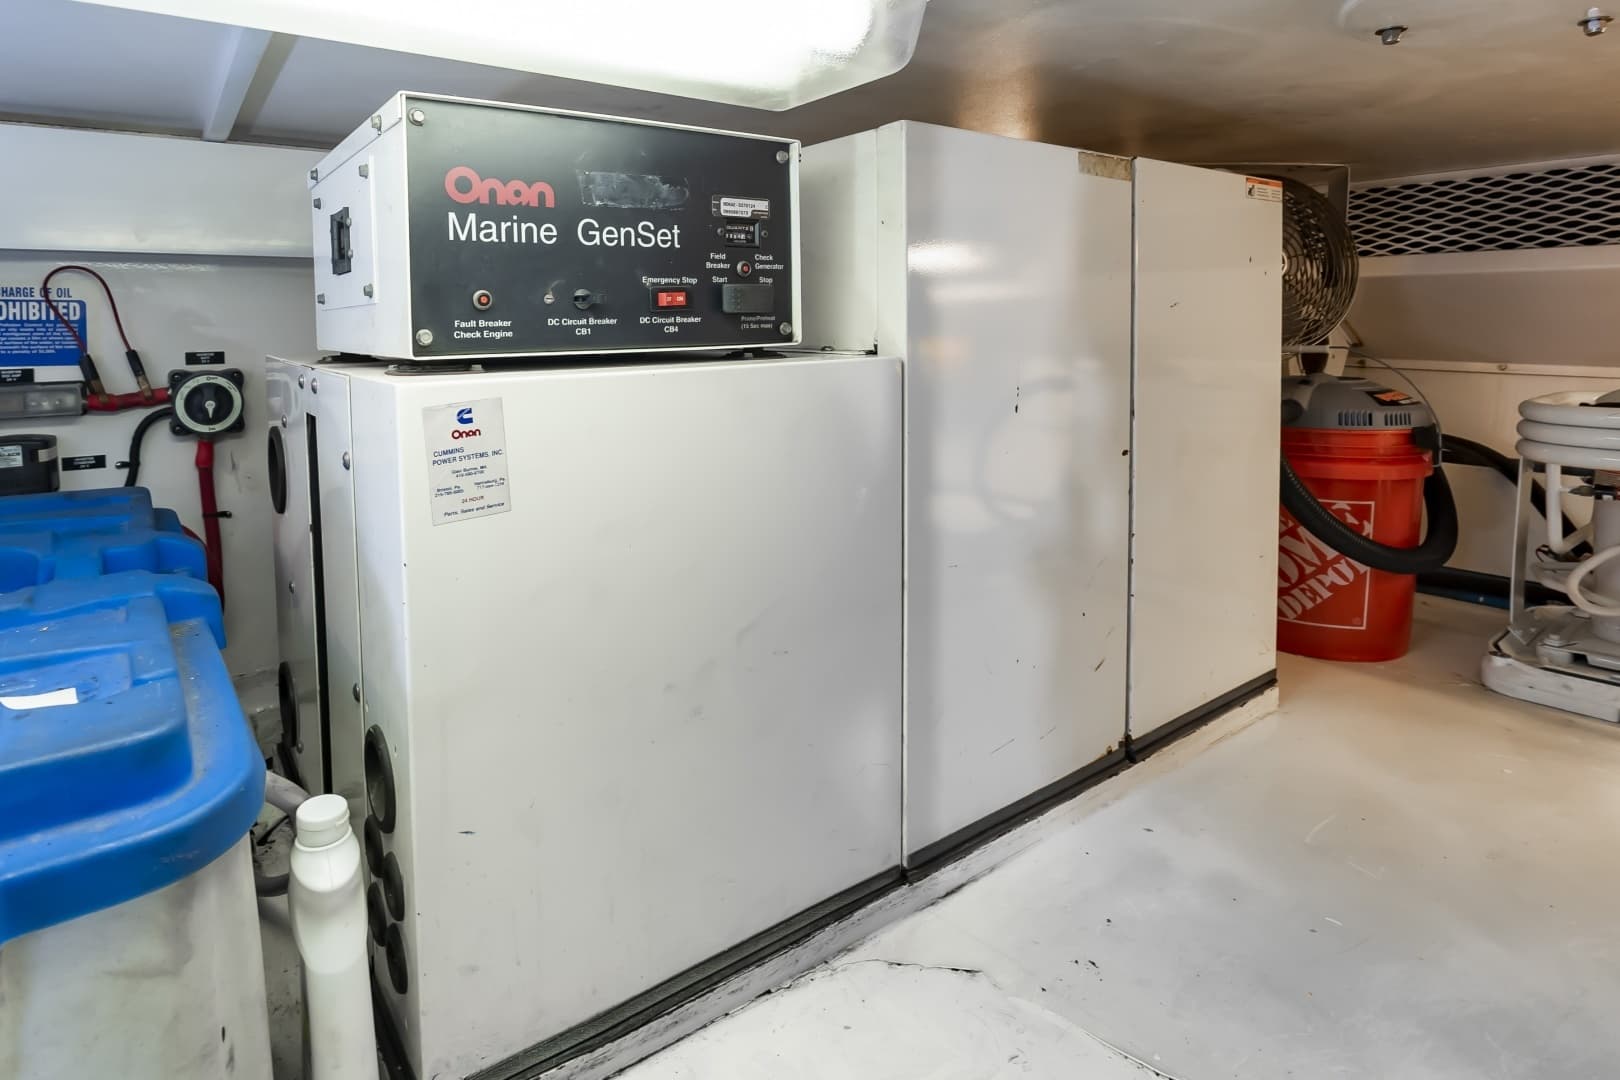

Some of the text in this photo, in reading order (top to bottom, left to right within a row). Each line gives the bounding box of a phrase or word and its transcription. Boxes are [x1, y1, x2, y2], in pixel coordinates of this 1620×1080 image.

[445, 166, 555, 208] Onan
[448, 212, 681, 248] Marine GenSet
[710, 252, 726, 260] Field
[705, 261, 731, 269] Breaker
[642, 276, 698, 287] Emergency Stop
[759, 276, 774, 286] Stop
[56, 288, 73, 298] OIL
[454, 320, 512, 328] Fault Breaker
[548, 317, 618, 326] DC Circuit Breaker
[640, 316, 702, 324] DC Circuit Breaker
[576, 328, 592, 336] CB1
[664, 325, 679, 334] CB4
[454, 330, 514, 340] Check Engine
[451, 428, 481, 440] Onan
[433, 446, 464, 458] CUMMINS
[432, 456, 458, 466] POWER
